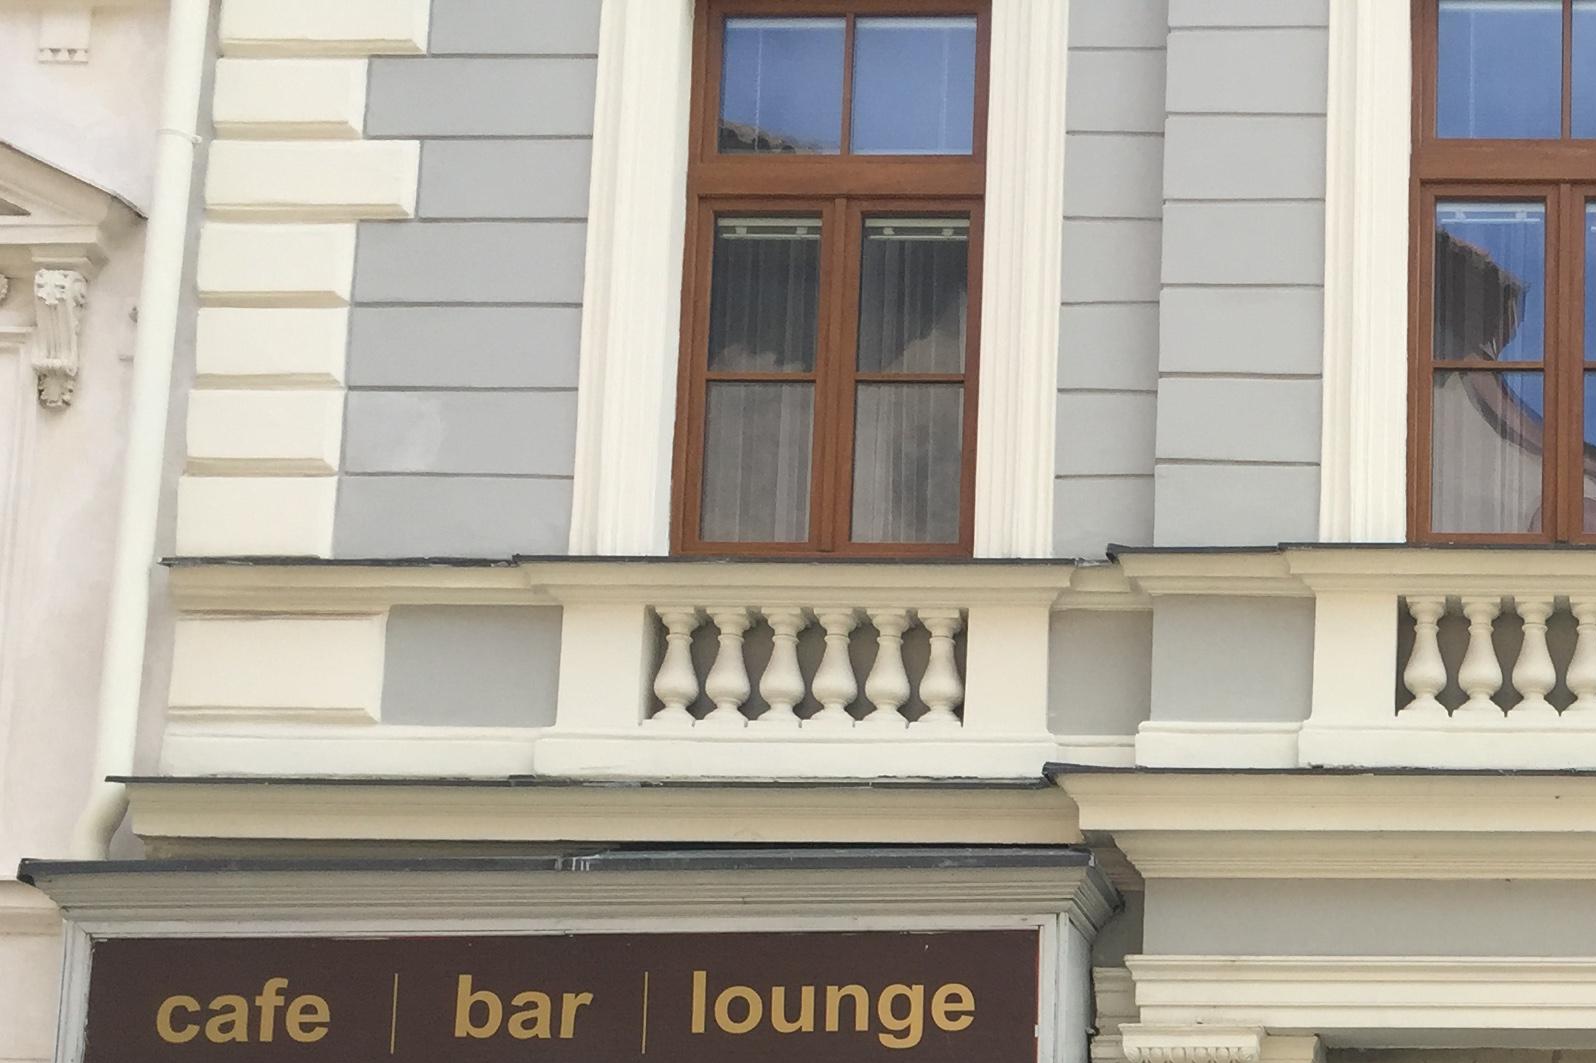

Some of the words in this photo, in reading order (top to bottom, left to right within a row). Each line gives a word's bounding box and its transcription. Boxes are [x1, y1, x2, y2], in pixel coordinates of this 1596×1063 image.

[156, 978, 331, 1044] cafe
[453, 974, 592, 1040] bar
[691, 970, 976, 1049] lounge
